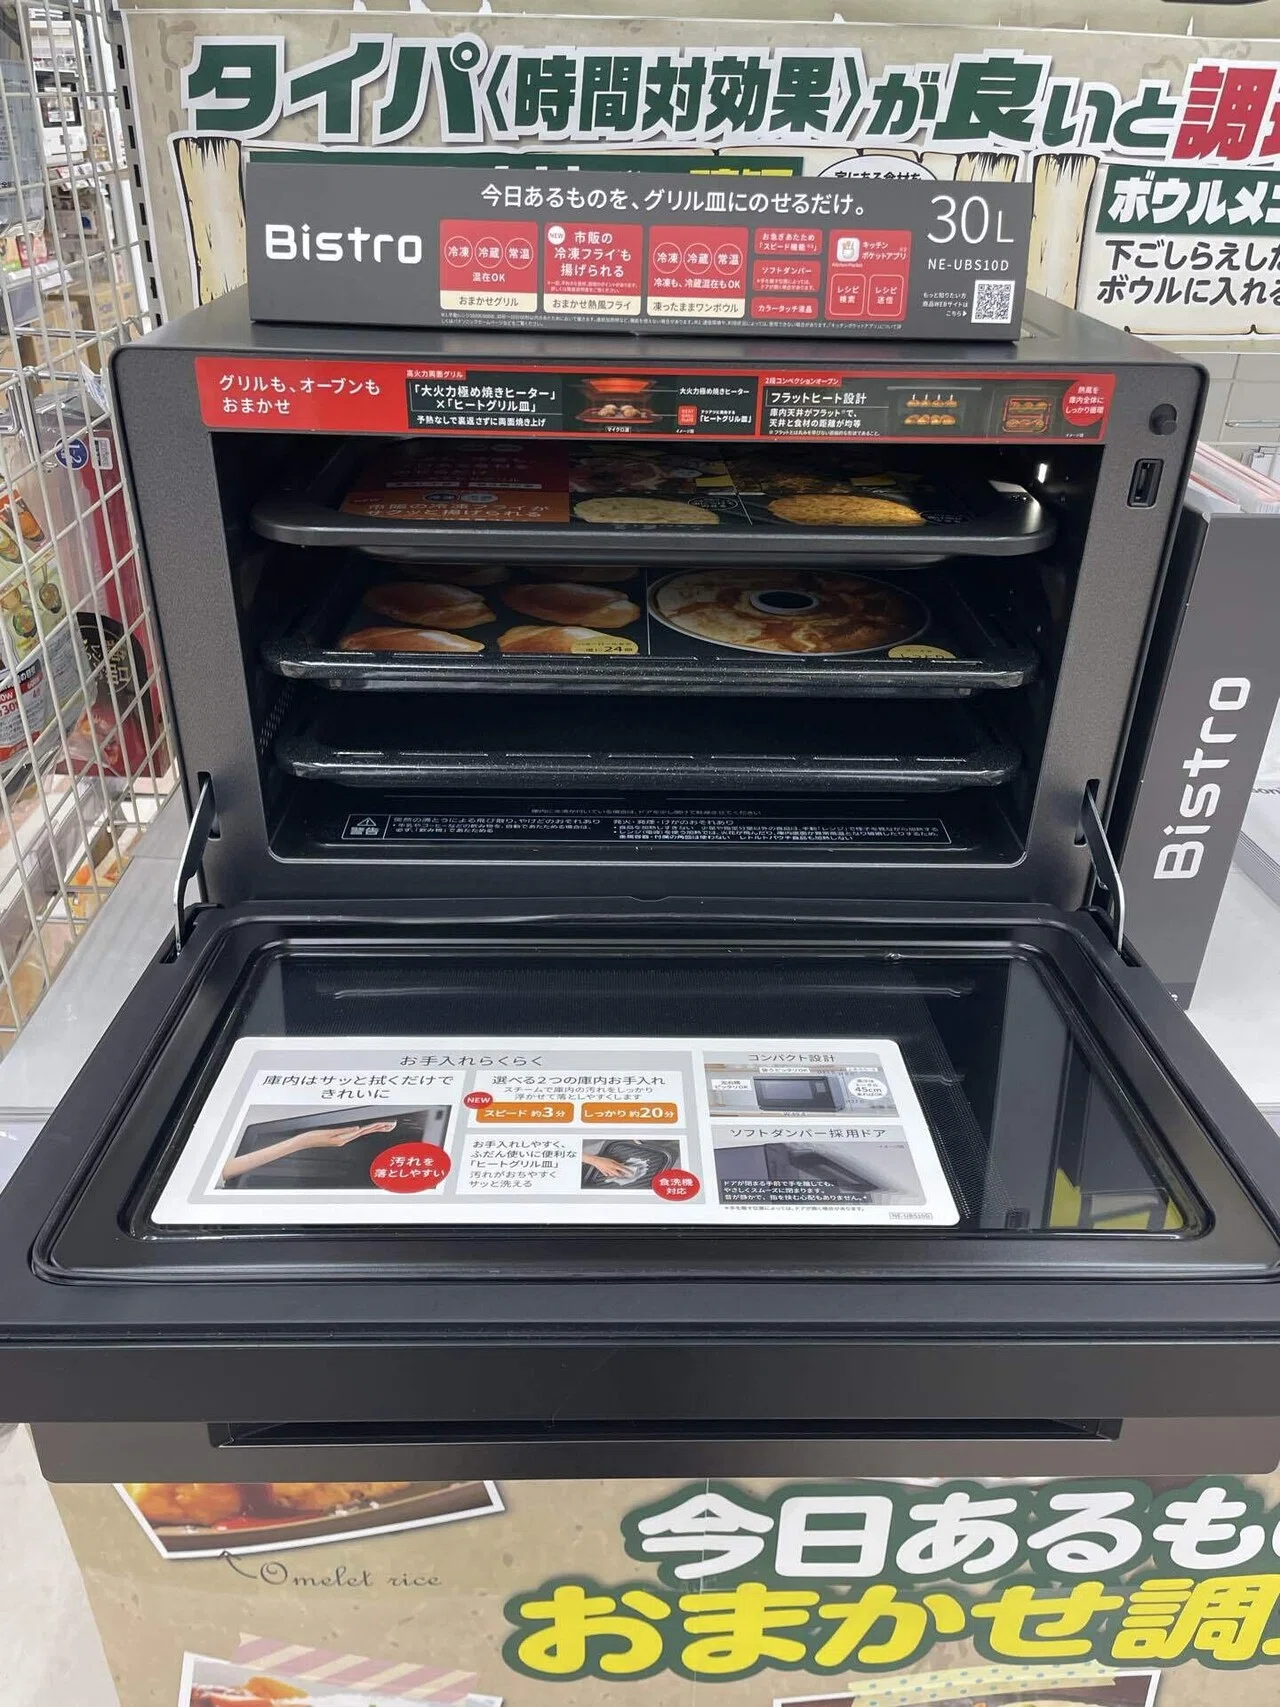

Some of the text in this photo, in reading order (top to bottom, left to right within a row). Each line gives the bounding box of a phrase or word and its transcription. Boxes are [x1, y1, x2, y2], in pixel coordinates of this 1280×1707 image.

[186, 41, 1280, 162] タイパ〈時間対効果〉が良いと調
[481, 183, 865, 216] 今日あるものを、グリル皿にのせるだけ。
[549, 232, 565, 240] NEW
[574, 231, 613, 245] 市販の
[762, 232, 816, 242] お急ぎあたため
[265, 223, 422, 264] Bistro
[862, 241, 889, 250] キッチン
[447, 245, 470, 259] 冷凍
[478, 246, 500, 260] 冷蔵
[508, 247, 531, 260] 常温
[656, 251, 679, 264] 冷凍
[861, 251, 908, 261] ポケットアプリ
[686, 252, 709, 265] 冷蔵
[717, 253, 740, 266] 常温
[560, 263, 625, 278] 揚げられる
[927, 258, 1010, 272] NE-UBS10D
[653, 278, 741, 290] 冷凍も、冷蔵混在もOK
[836, 285, 860, 294] レシピ
[875, 286, 898, 295] レシピ
[458, 296, 519, 308] おまかせグリル
[552, 298, 632, 311] おまかせ熱風フライ
[877, 296, 894, 305] 送信
[922, 300, 969, 309] 商品WEBサイトは
[652, 302, 739, 314] 凍ったままワンボウル
[758, 304, 813, 314] カラータッチ液晶
[406, 369, 464, 379] 高火力両面グリル
[218, 374, 381, 396] グリルも、オーブンも
[765, 377, 840, 386] 2段コンベクションオーブン
[413, 384, 557, 401] 「大火力極め焼きヒーター」
[679, 387, 750, 396] 大火力極め焼きヒーター
[771, 392, 867, 405] フラットヒート設計
[1068, 396, 1105, 405] 庫内全体に
[222, 396, 291, 415] おまかせ
[436, 398, 537, 413] ×「ヒートグリル皿」
[416, 414, 547, 428] 予熱なしで裏返さずに両面焼き上げ
[699, 414, 752, 424] 「ヒートグリル皿」
[769, 418, 861, 429] 天井と食材の距離が均等
[1153, 677, 1251, 880] Bistro
[400, 1055, 544, 1067] お手入れらくらく
[748, 1053, 836, 1063] コンパクト設計
[262, 1074, 455, 1086] 庫内はサッと拭くだけで
[491, 1075, 666, 1086] 選べる2つの庫内お手入れ
[320, 1088, 391, 1100] きれいに
[504, 1086, 654, 1094] スチームで庫内の汚れをしっかり
[466, 1096, 492, 1104] NEW
[514, 1093, 643, 1101] 浮かせて落としやすくします
[483, 1107, 567, 1118] スピード 約3分
[584, 1107, 675, 1119] しっかり 約20分
[472, 1140, 566, 1149] お手入れしやすく、
[470, 1150, 578, 1159] ふだん使いに便利な
[389, 1156, 434, 1168] 汚れを
[470, 1160, 560, 1169] 「ヒートグリル皿」
[373, 1168, 446, 1178] 落としやすい
[469, 1170, 557, 1179] 汚れがおちやすく
[468, 1180, 533, 1188] サッと洗える
[658, 1178, 694, 1187] 食洗機
[666, 1187, 688, 1196] 対応
[637, 1486, 1280, 1580] 今日あるも
[259, 1560, 443, 1588] Omelet rice
[518, 1573, 1280, 1674] おまかせ調
